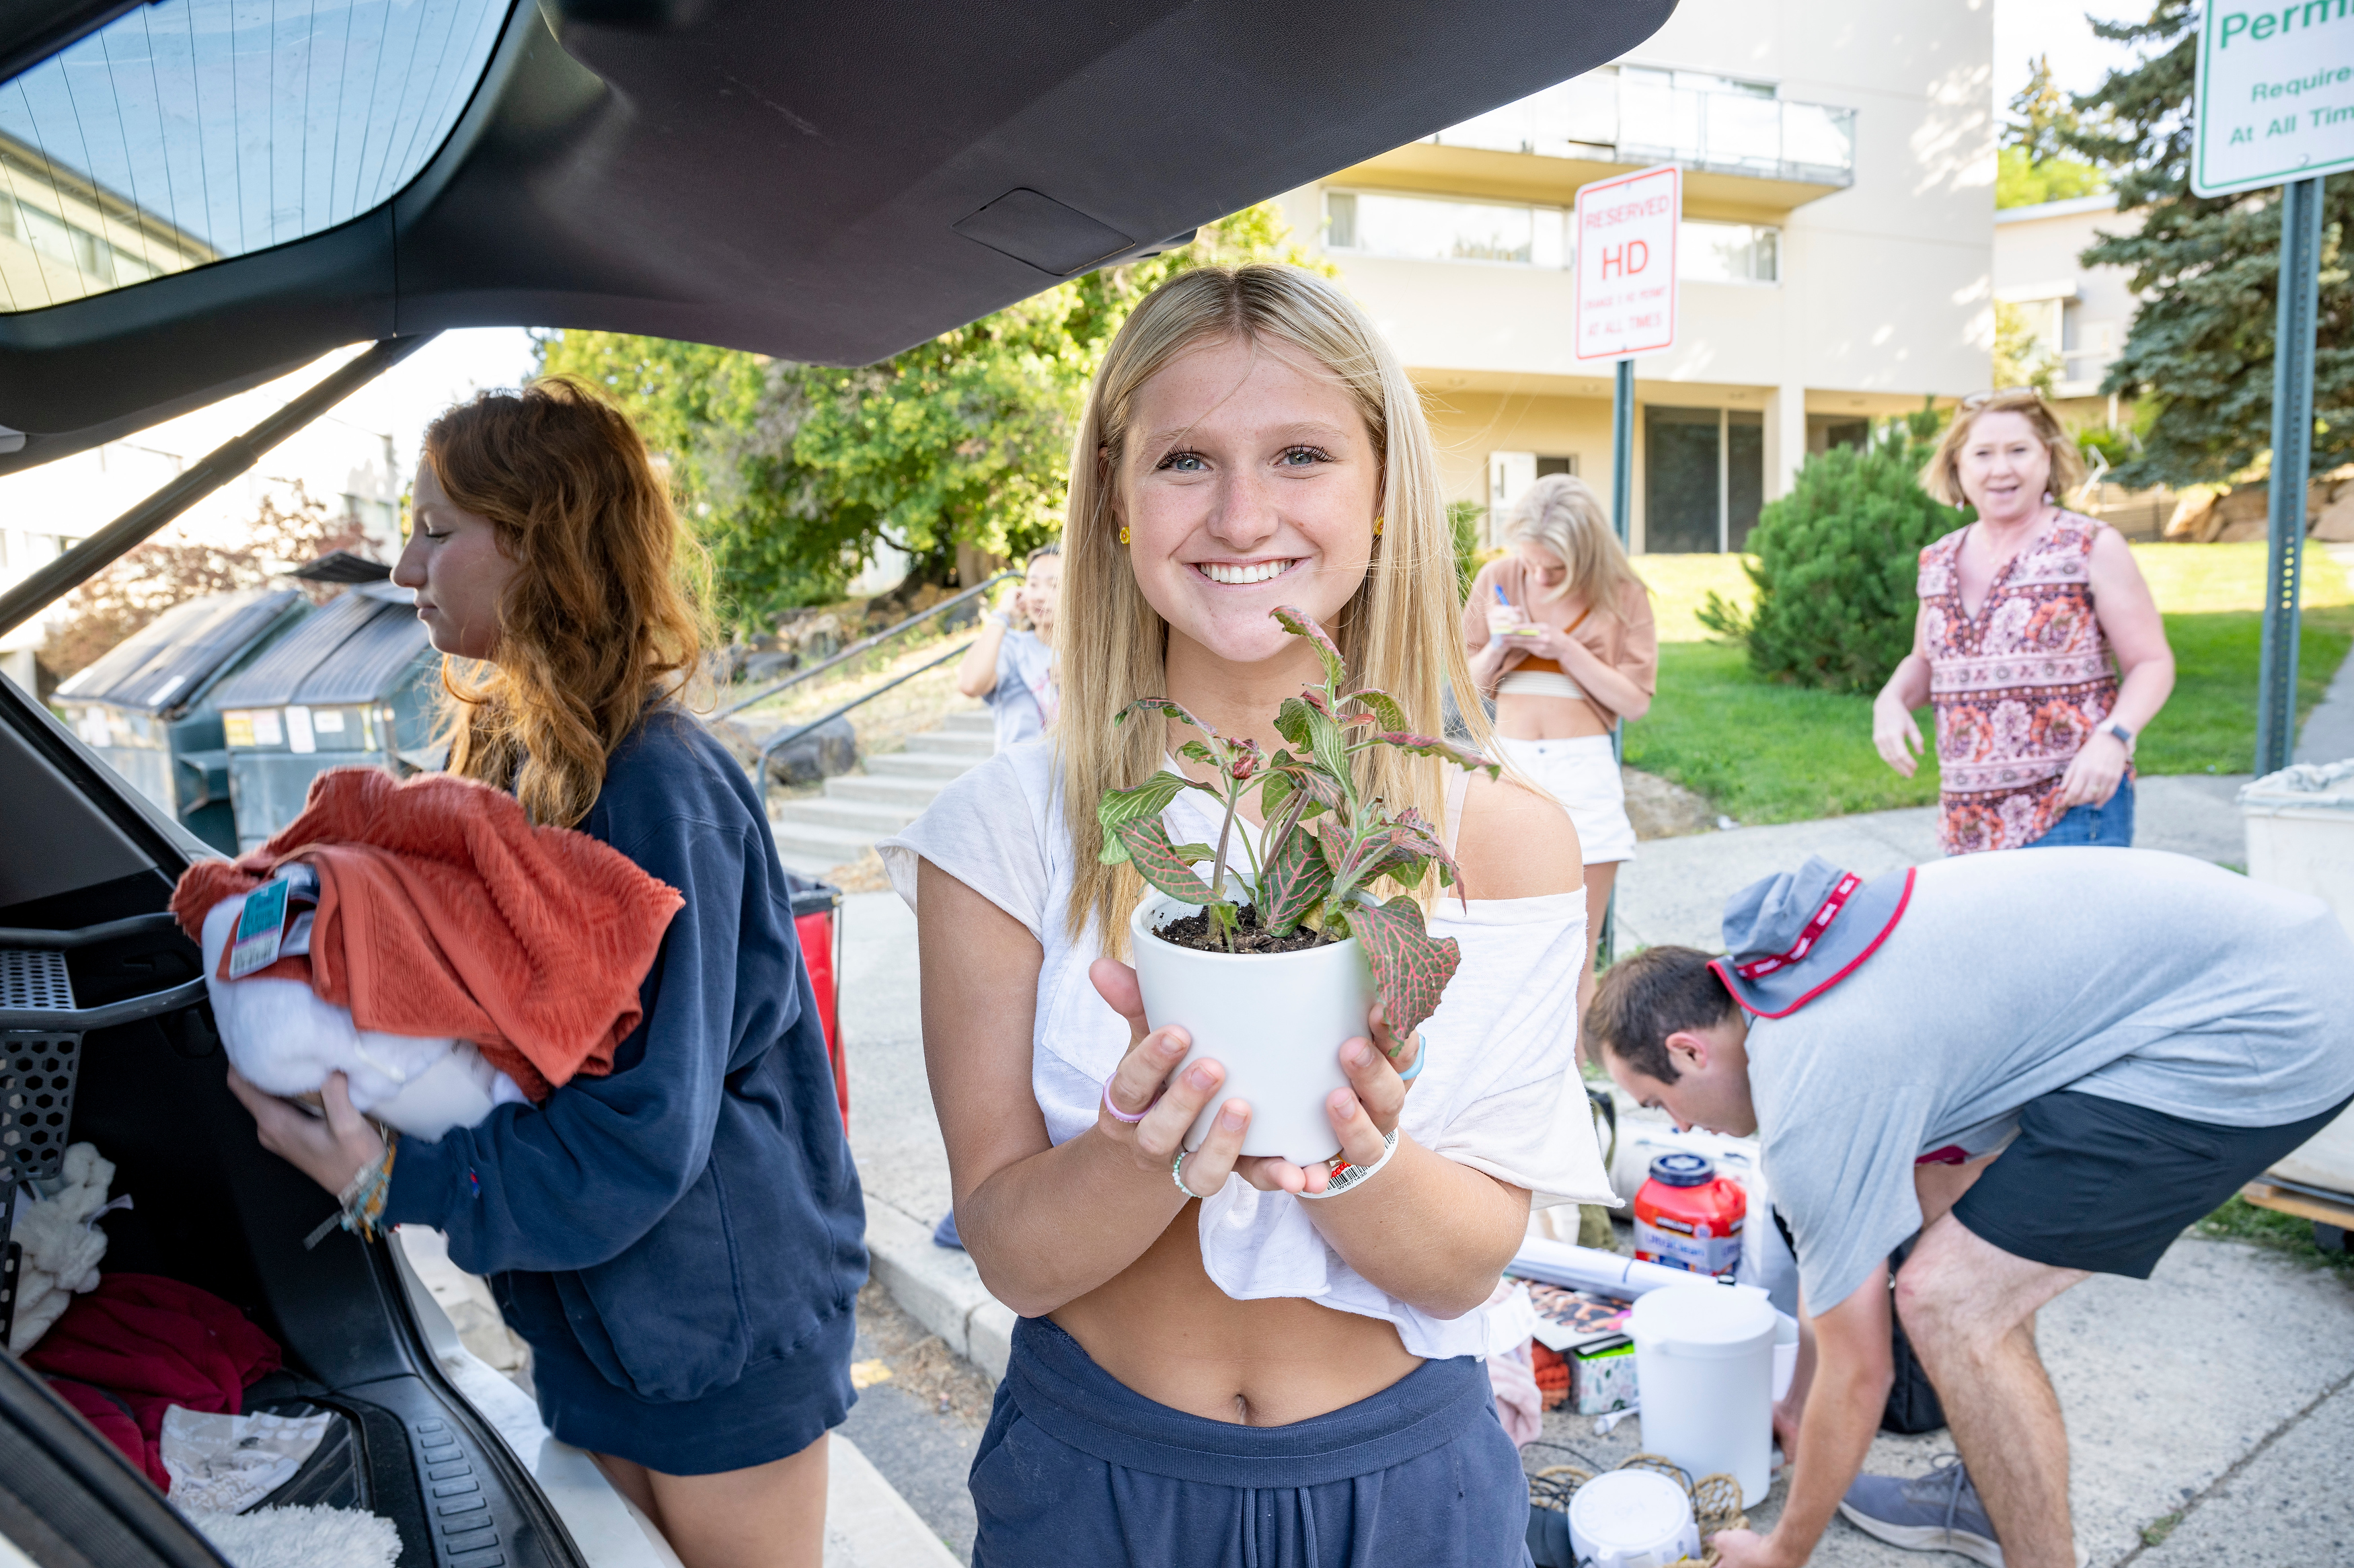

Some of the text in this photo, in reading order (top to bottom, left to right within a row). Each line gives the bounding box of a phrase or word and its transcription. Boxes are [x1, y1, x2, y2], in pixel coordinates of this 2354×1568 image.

[2219, 0, 2354, 49] Perm
[2252, 66, 2354, 102] Require
[2230, 126, 2253, 145] At
[2266, 115, 2297, 139] All
[1585, 194, 1670, 229] RESERVED
[1601, 239, 1649, 280] HD
[1604, 319, 1622, 334] ALL
[1629, 311, 1662, 329] TIMES
